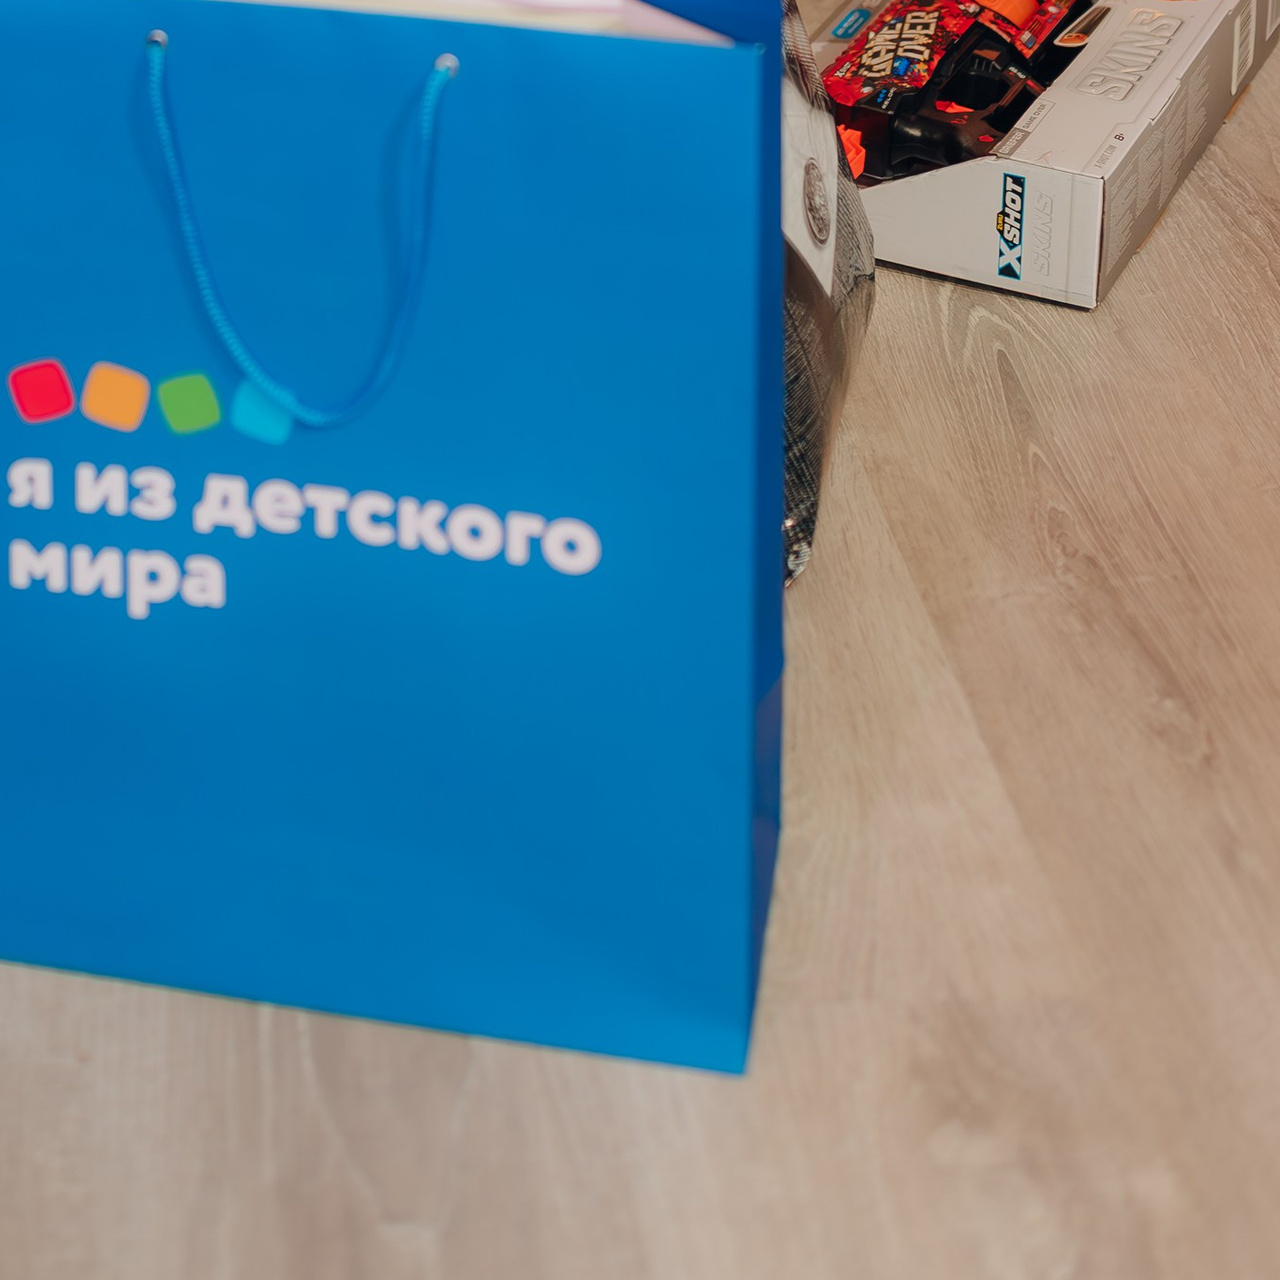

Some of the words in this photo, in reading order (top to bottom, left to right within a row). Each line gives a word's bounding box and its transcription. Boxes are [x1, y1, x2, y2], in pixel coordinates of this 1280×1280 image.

[896, 11, 940, 62] OVER
[1074, 7, 1184, 102] SKINS
[1032, 190, 1053, 276] SKINS
[7, 456, 54, 509] я
[74, 460, 176, 521] из
[192, 472, 602, 576] детского
[8, 538, 227, 620] мира
